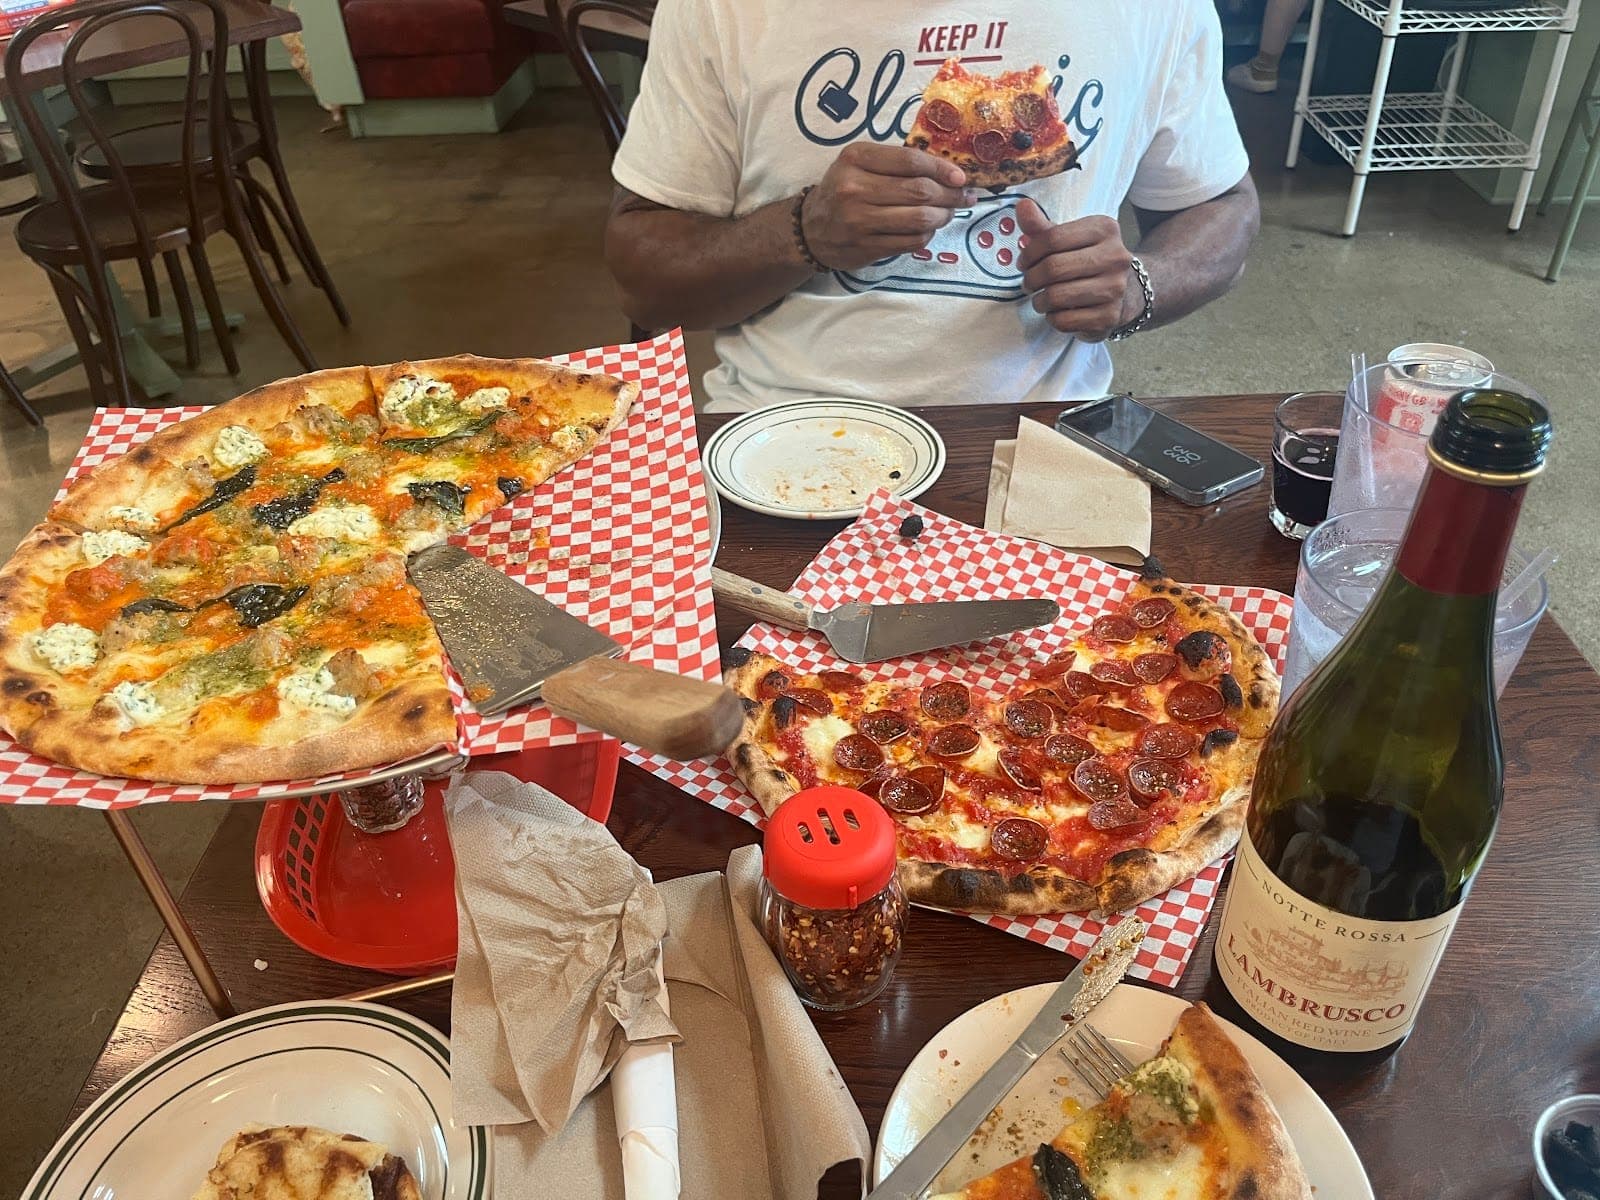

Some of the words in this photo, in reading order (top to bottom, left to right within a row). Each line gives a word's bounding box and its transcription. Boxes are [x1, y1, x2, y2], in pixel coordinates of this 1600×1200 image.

[918, 24, 977, 53] KEEP
[984, 21, 1008, 50] IT
[1261, 881, 1327, 930] NOTTE
[1334, 926, 1407, 943] ROSSA
[1228, 932, 1407, 1023] LAMBRUSCO
[1236, 976, 1289, 1021] ITALIAN
[1292, 1017, 1324, 1034] RED
[1327, 1028, 1373, 1038] WINE
